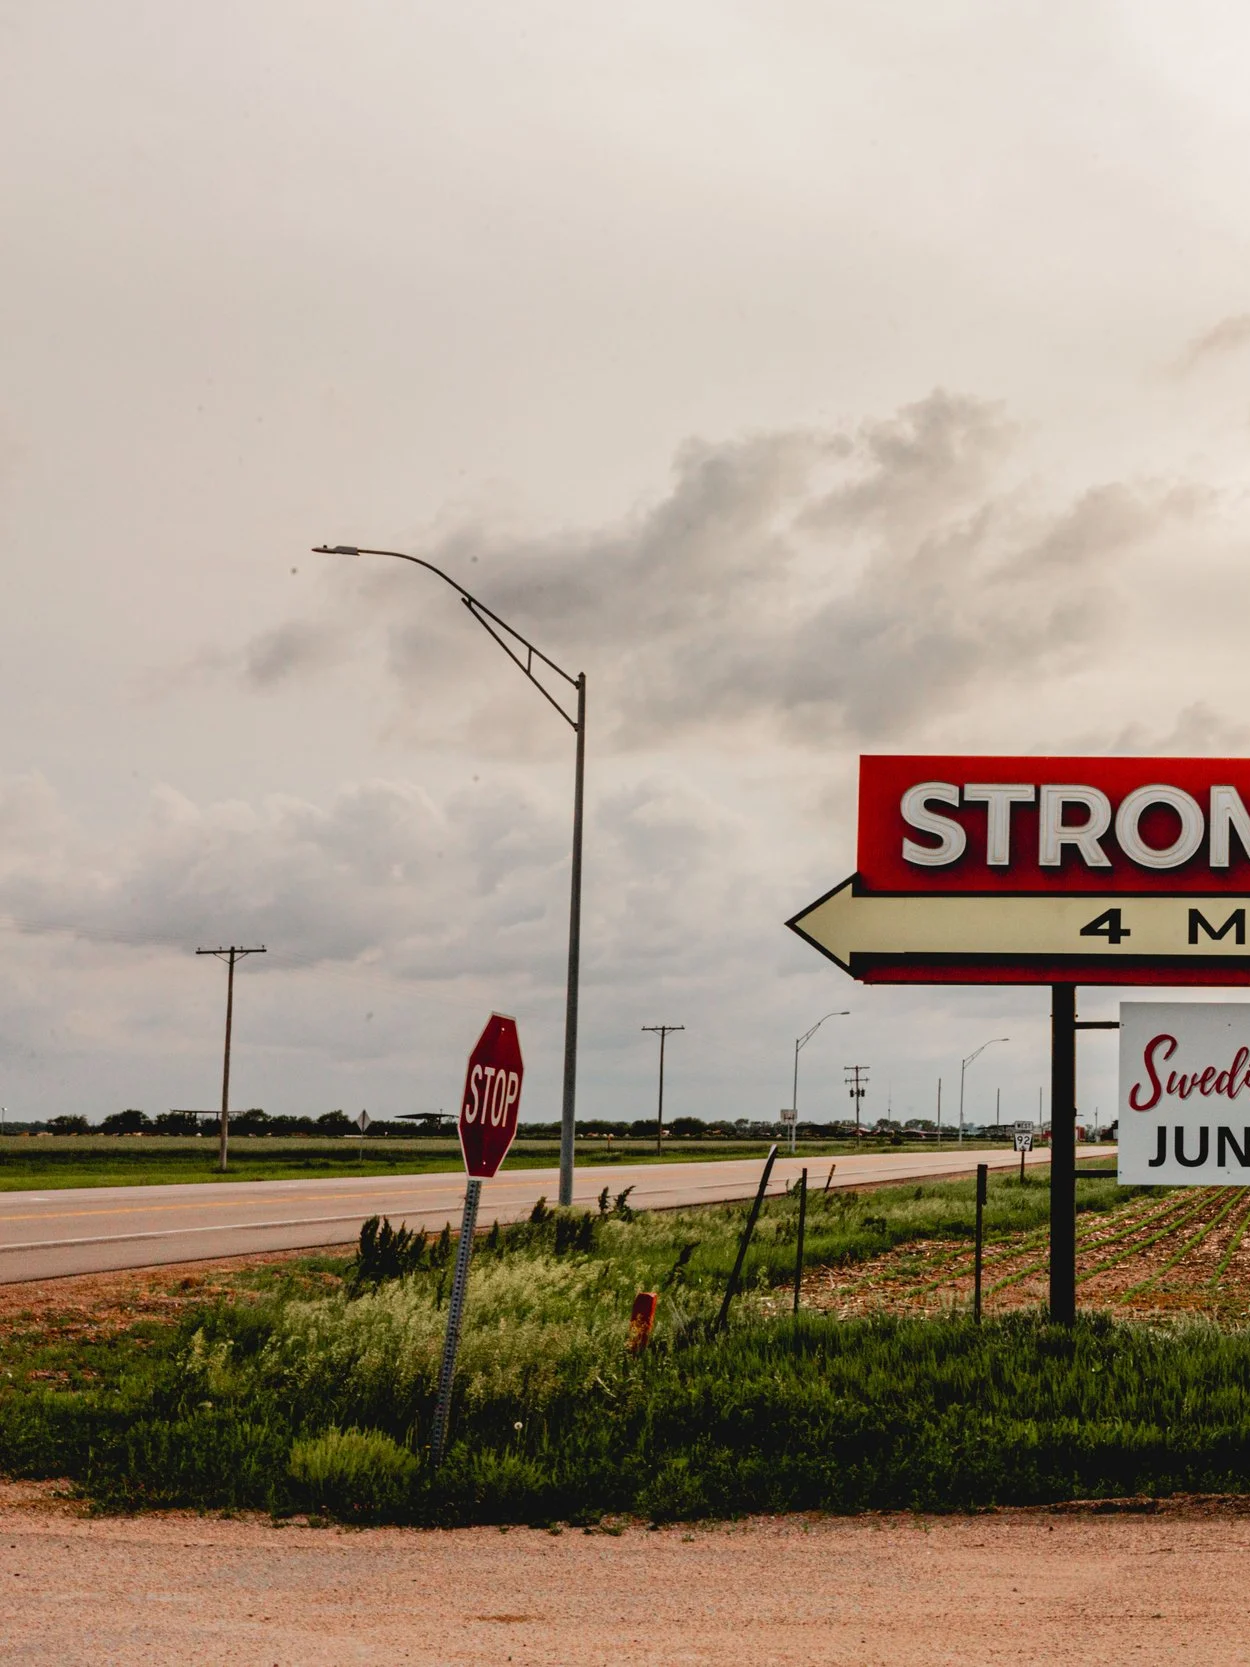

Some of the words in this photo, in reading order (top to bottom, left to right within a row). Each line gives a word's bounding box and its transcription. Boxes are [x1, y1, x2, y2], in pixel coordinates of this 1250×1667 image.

[1079, 907, 1131, 945] 4
[465, 1064, 519, 1128] STOP
[1016, 1135, 1030, 1145] 92
